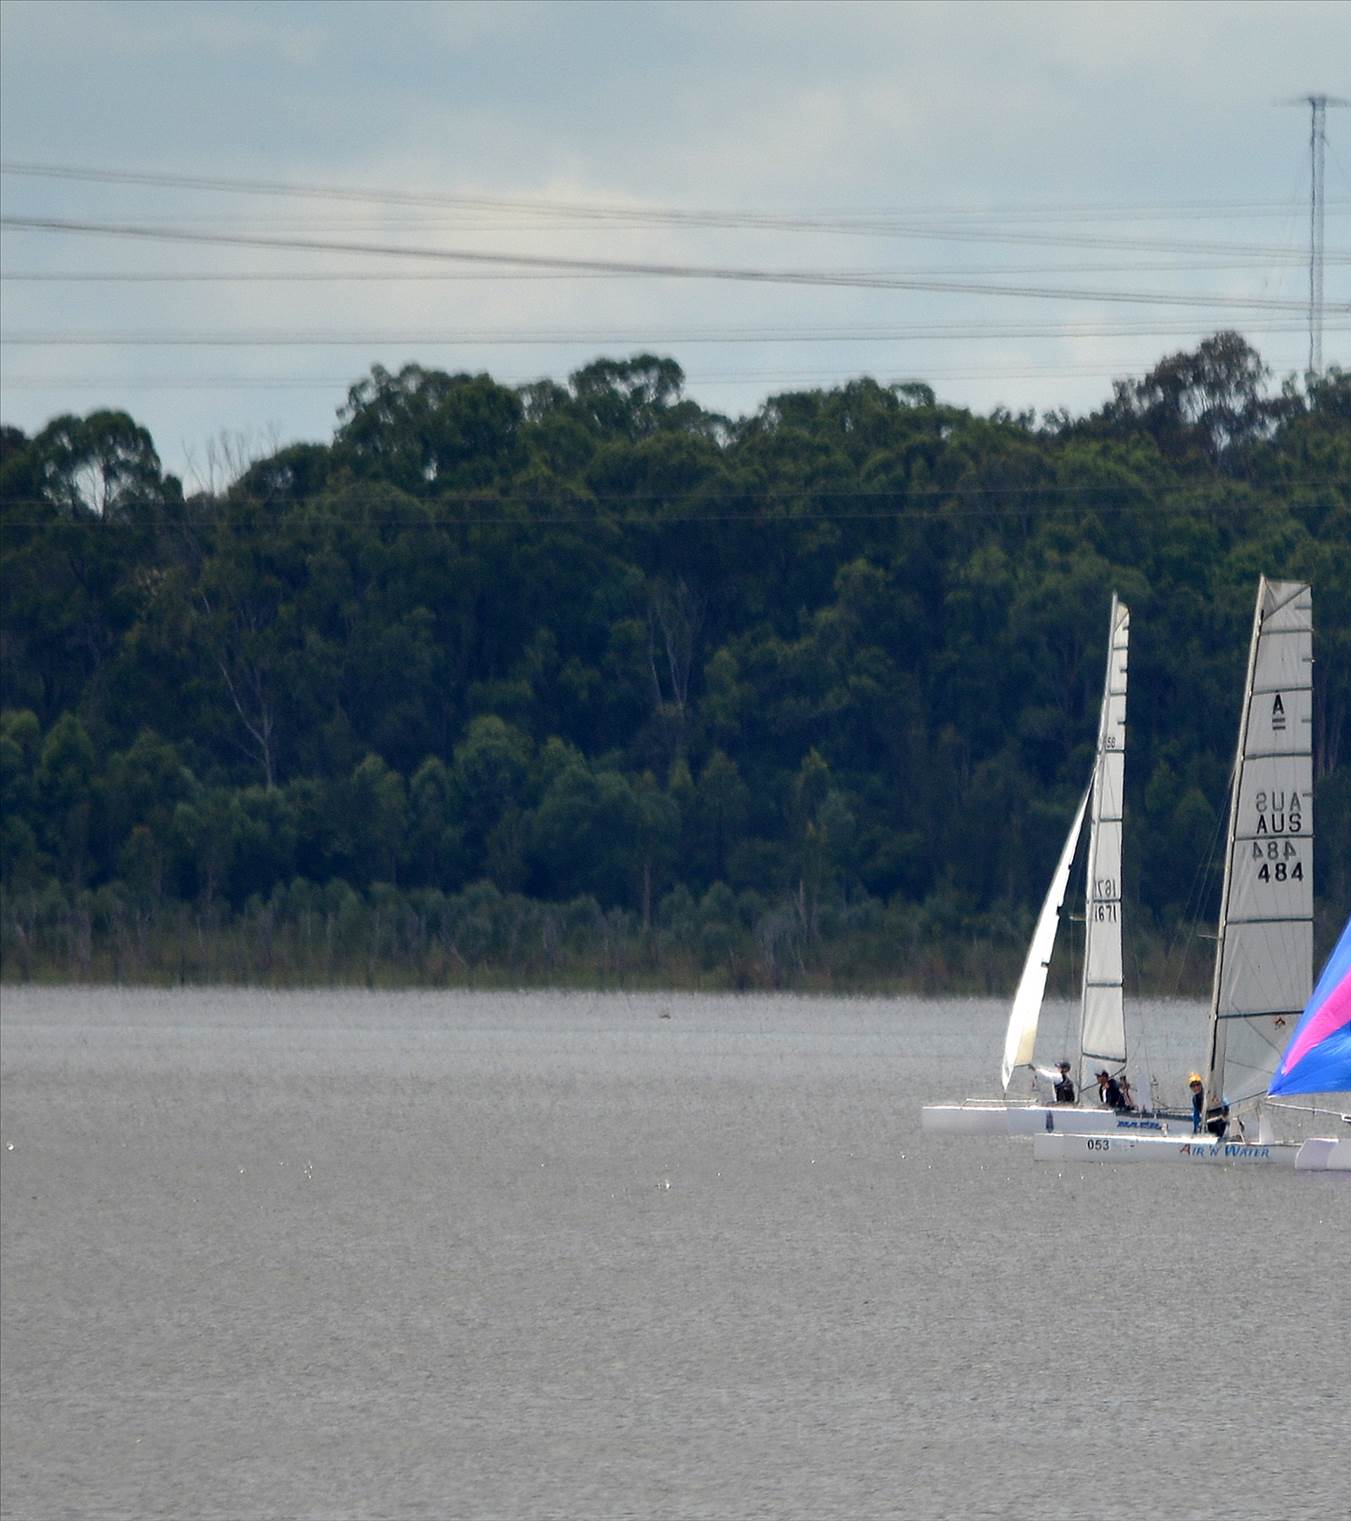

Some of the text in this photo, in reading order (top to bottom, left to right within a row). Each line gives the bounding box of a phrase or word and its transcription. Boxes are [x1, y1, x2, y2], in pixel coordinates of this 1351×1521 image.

[1272, 694, 1285, 715] A
[1256, 813, 1303, 834] AUS
[1258, 862, 1304, 883] 484
[1087, 1139, 1110, 1151] 053
[1180, 1144, 1205, 1156] AIR
